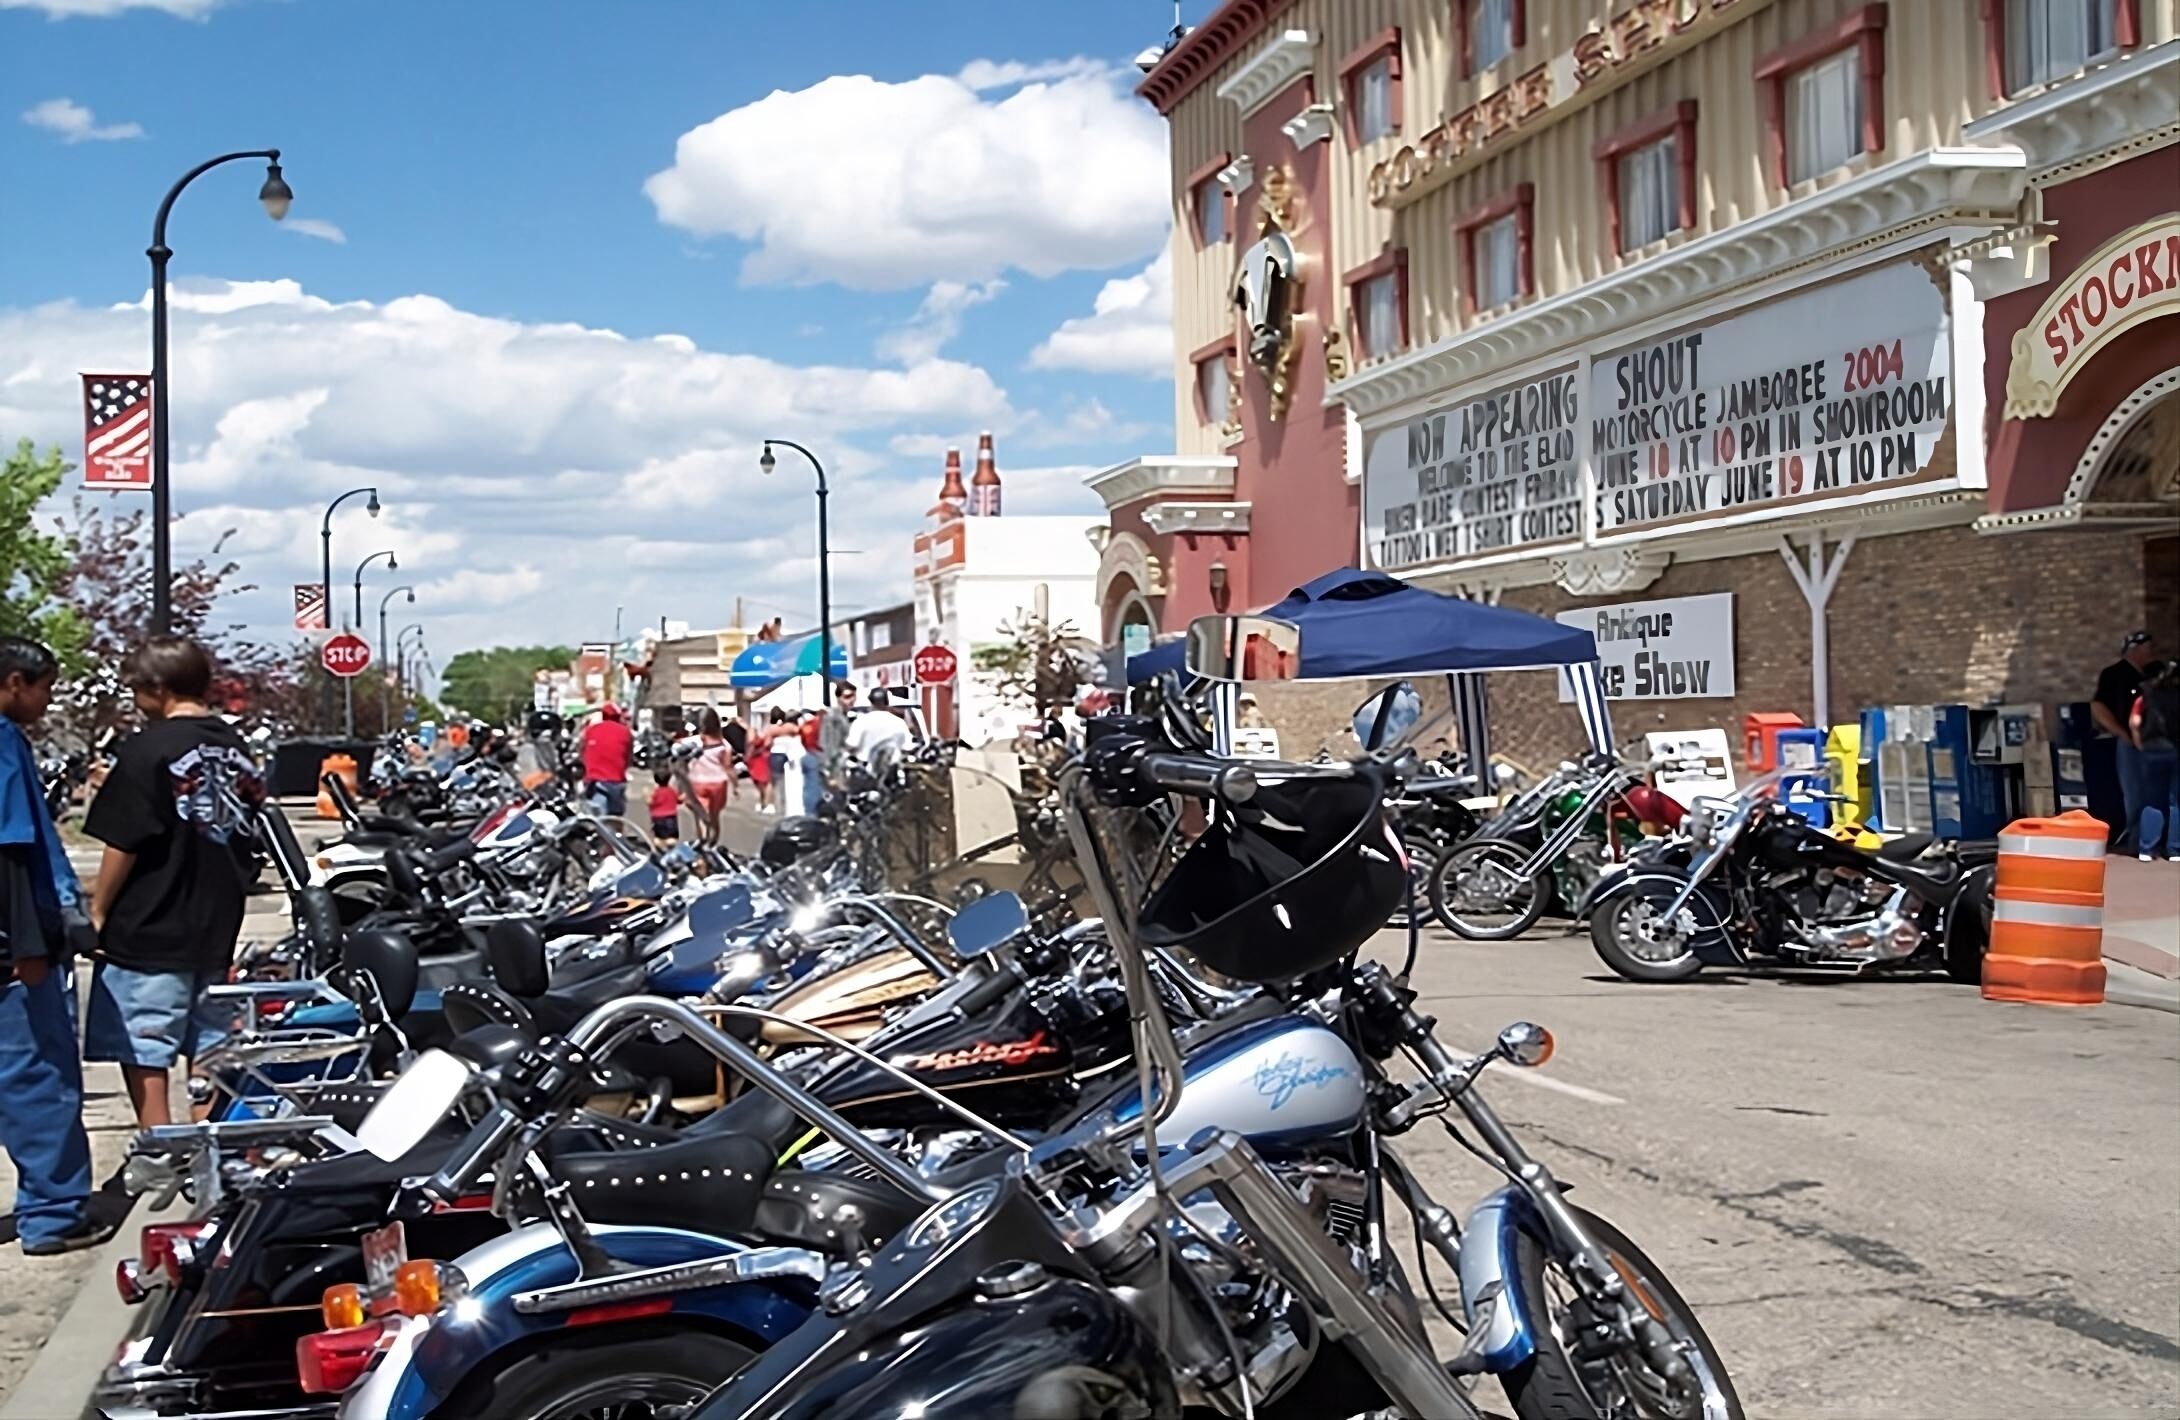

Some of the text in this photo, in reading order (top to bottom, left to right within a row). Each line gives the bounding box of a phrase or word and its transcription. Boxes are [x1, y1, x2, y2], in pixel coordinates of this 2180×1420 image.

[1593, 338, 1903, 455] MOTORCYCLE JAMBOREE 2004
[1617, 333, 1702, 410] SHOUT
[1460, 374, 1578, 453] APPEARING
[1680, 435, 1702, 474] AT
[1741, 418, 1771, 460] PM
[1779, 411, 1801, 452] IN
[1813, 376, 1945, 445] SHOWROOM
[1615, 474, 1711, 525] SATURDAY
[1721, 460, 1773, 507] JUNE
[1778, 456, 1804, 496] 19
[1813, 446, 1842, 490] AT
[1881, 432, 1917, 478] PM
[327, 646, 368, 664] STOP
[917, 656, 954, 673] STOP
[1597, 608, 1673, 648] Antique
[1634, 651, 1711, 696] Show
